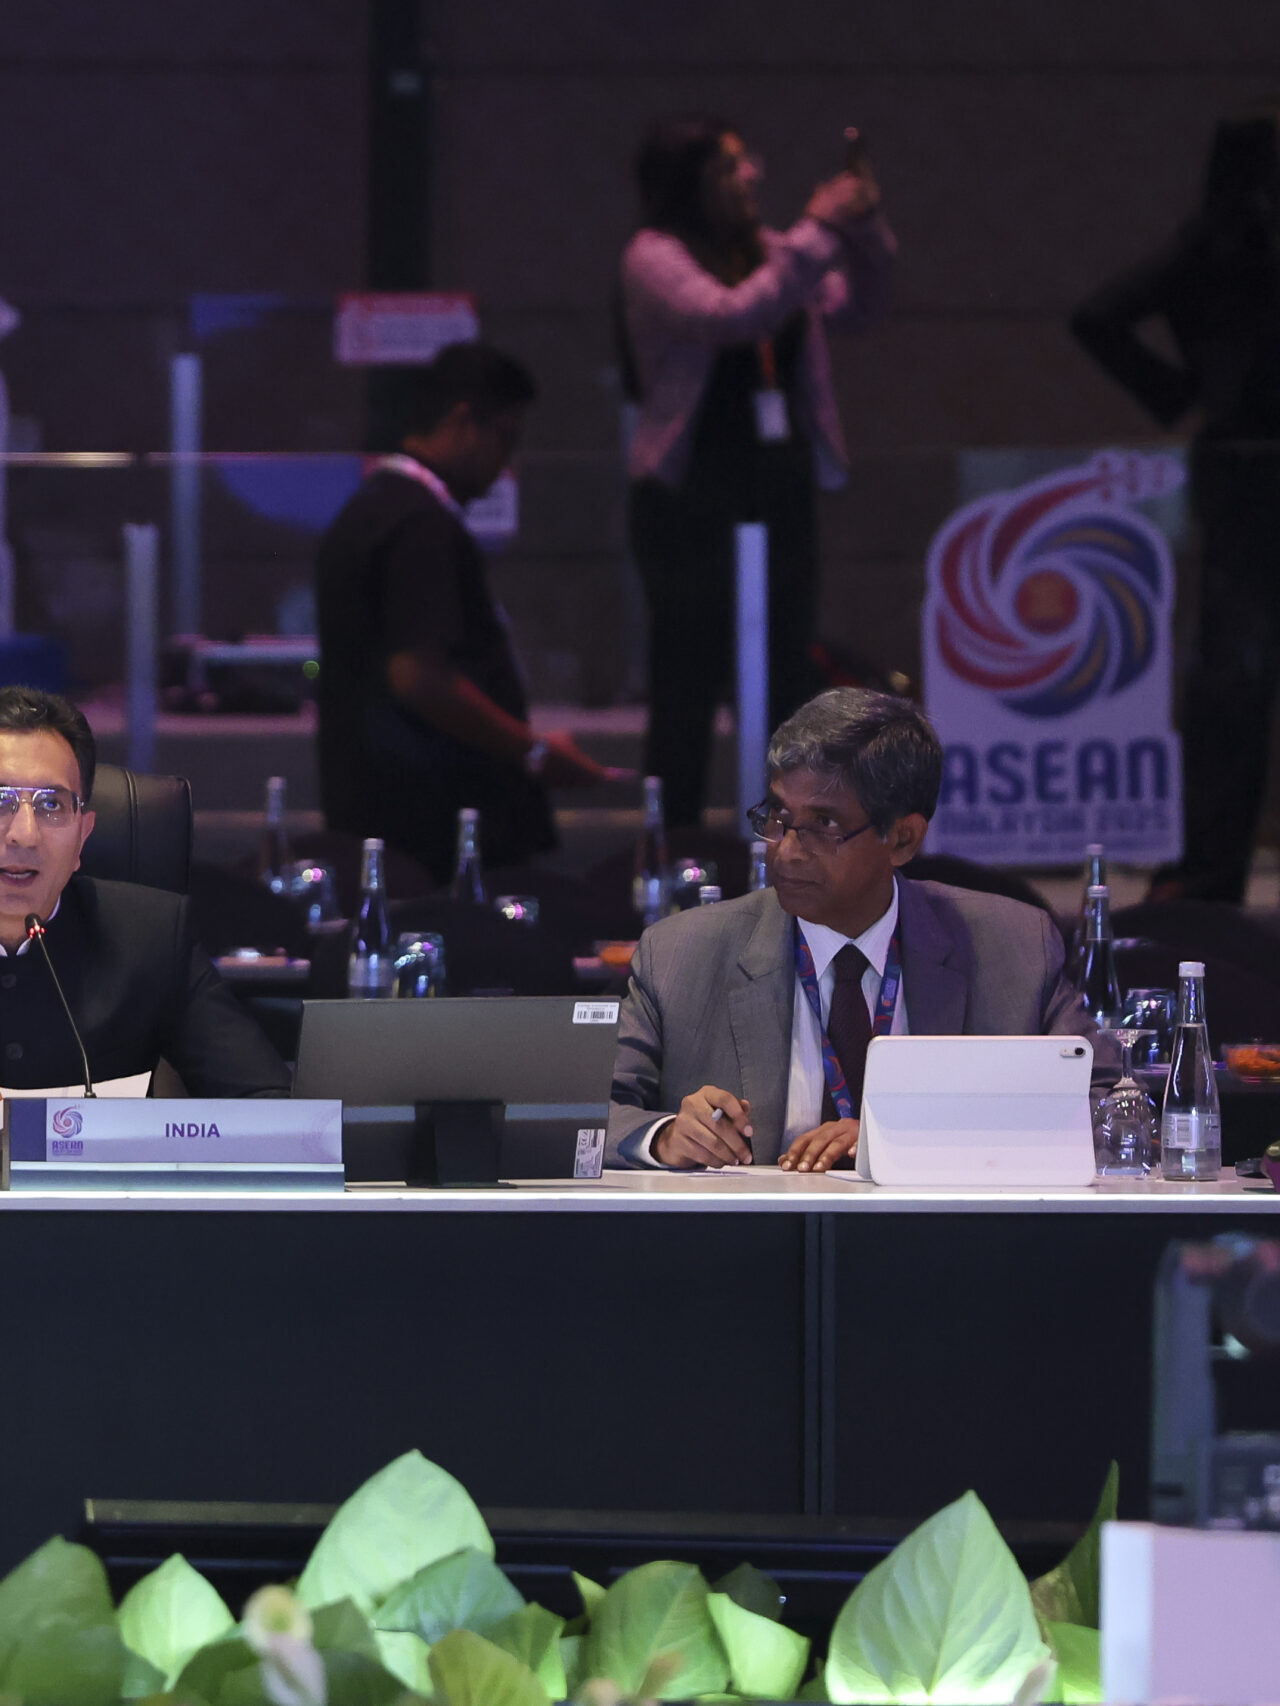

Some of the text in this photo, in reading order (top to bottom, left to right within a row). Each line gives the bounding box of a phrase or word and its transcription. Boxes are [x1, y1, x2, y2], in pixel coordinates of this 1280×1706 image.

[940, 739, 1169, 804] ASEAN
[165, 1123, 220, 1138] INDIA
[52, 1140, 83, 1150] ASEAN
